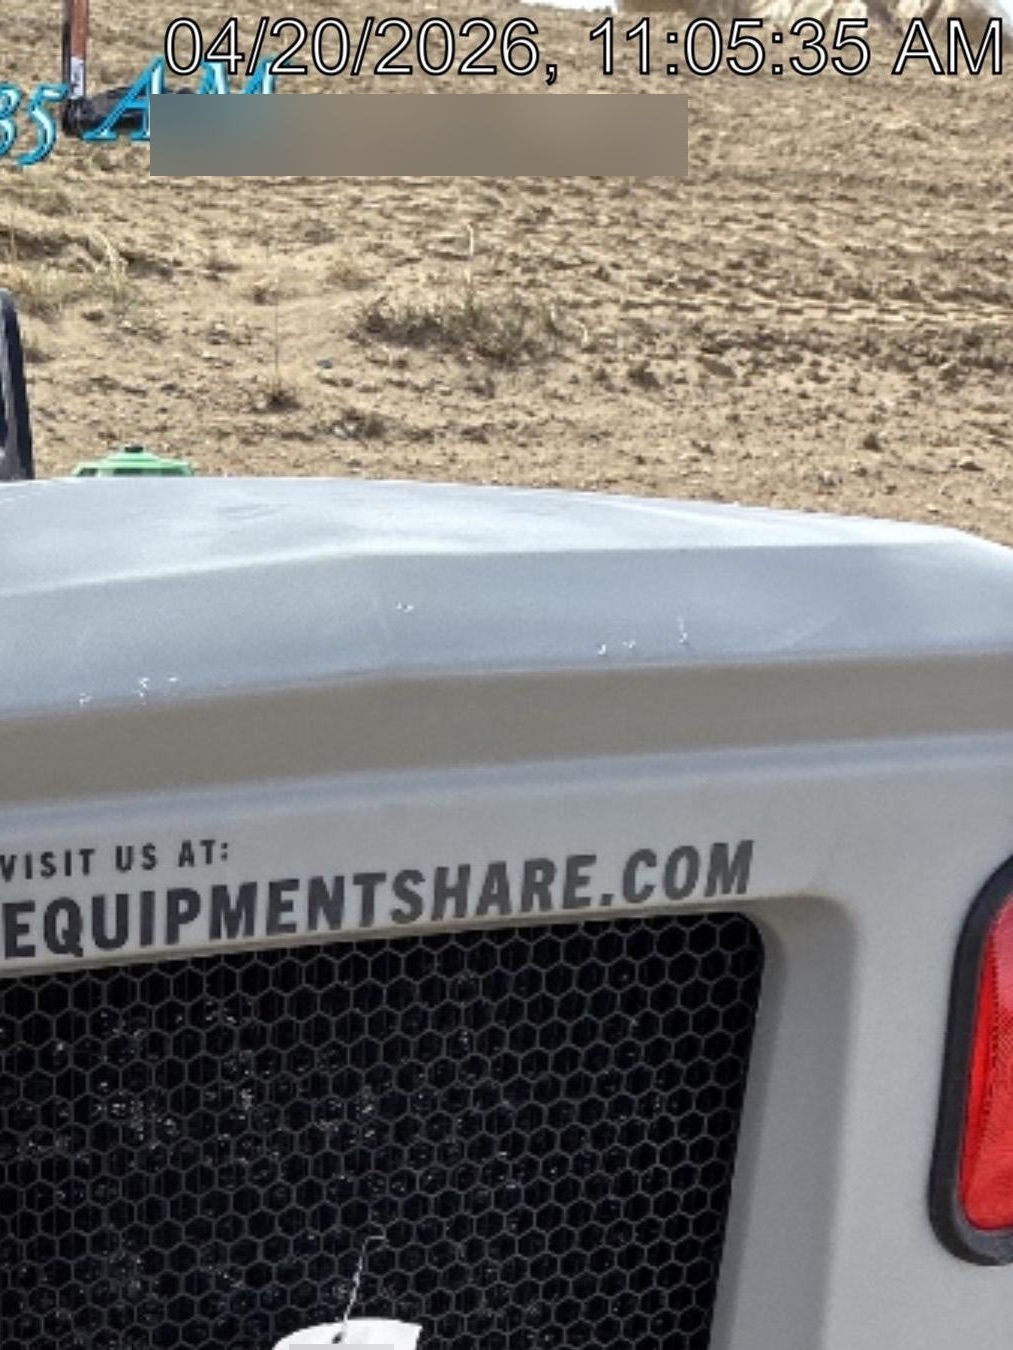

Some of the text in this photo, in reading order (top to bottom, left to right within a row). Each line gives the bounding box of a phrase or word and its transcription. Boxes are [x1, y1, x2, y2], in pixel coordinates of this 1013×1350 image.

[114, 842, 159, 873] US
[178, 838, 230, 867] AT:
[1, 839, 755, 959] EQUIPMENTSHARE.COM
